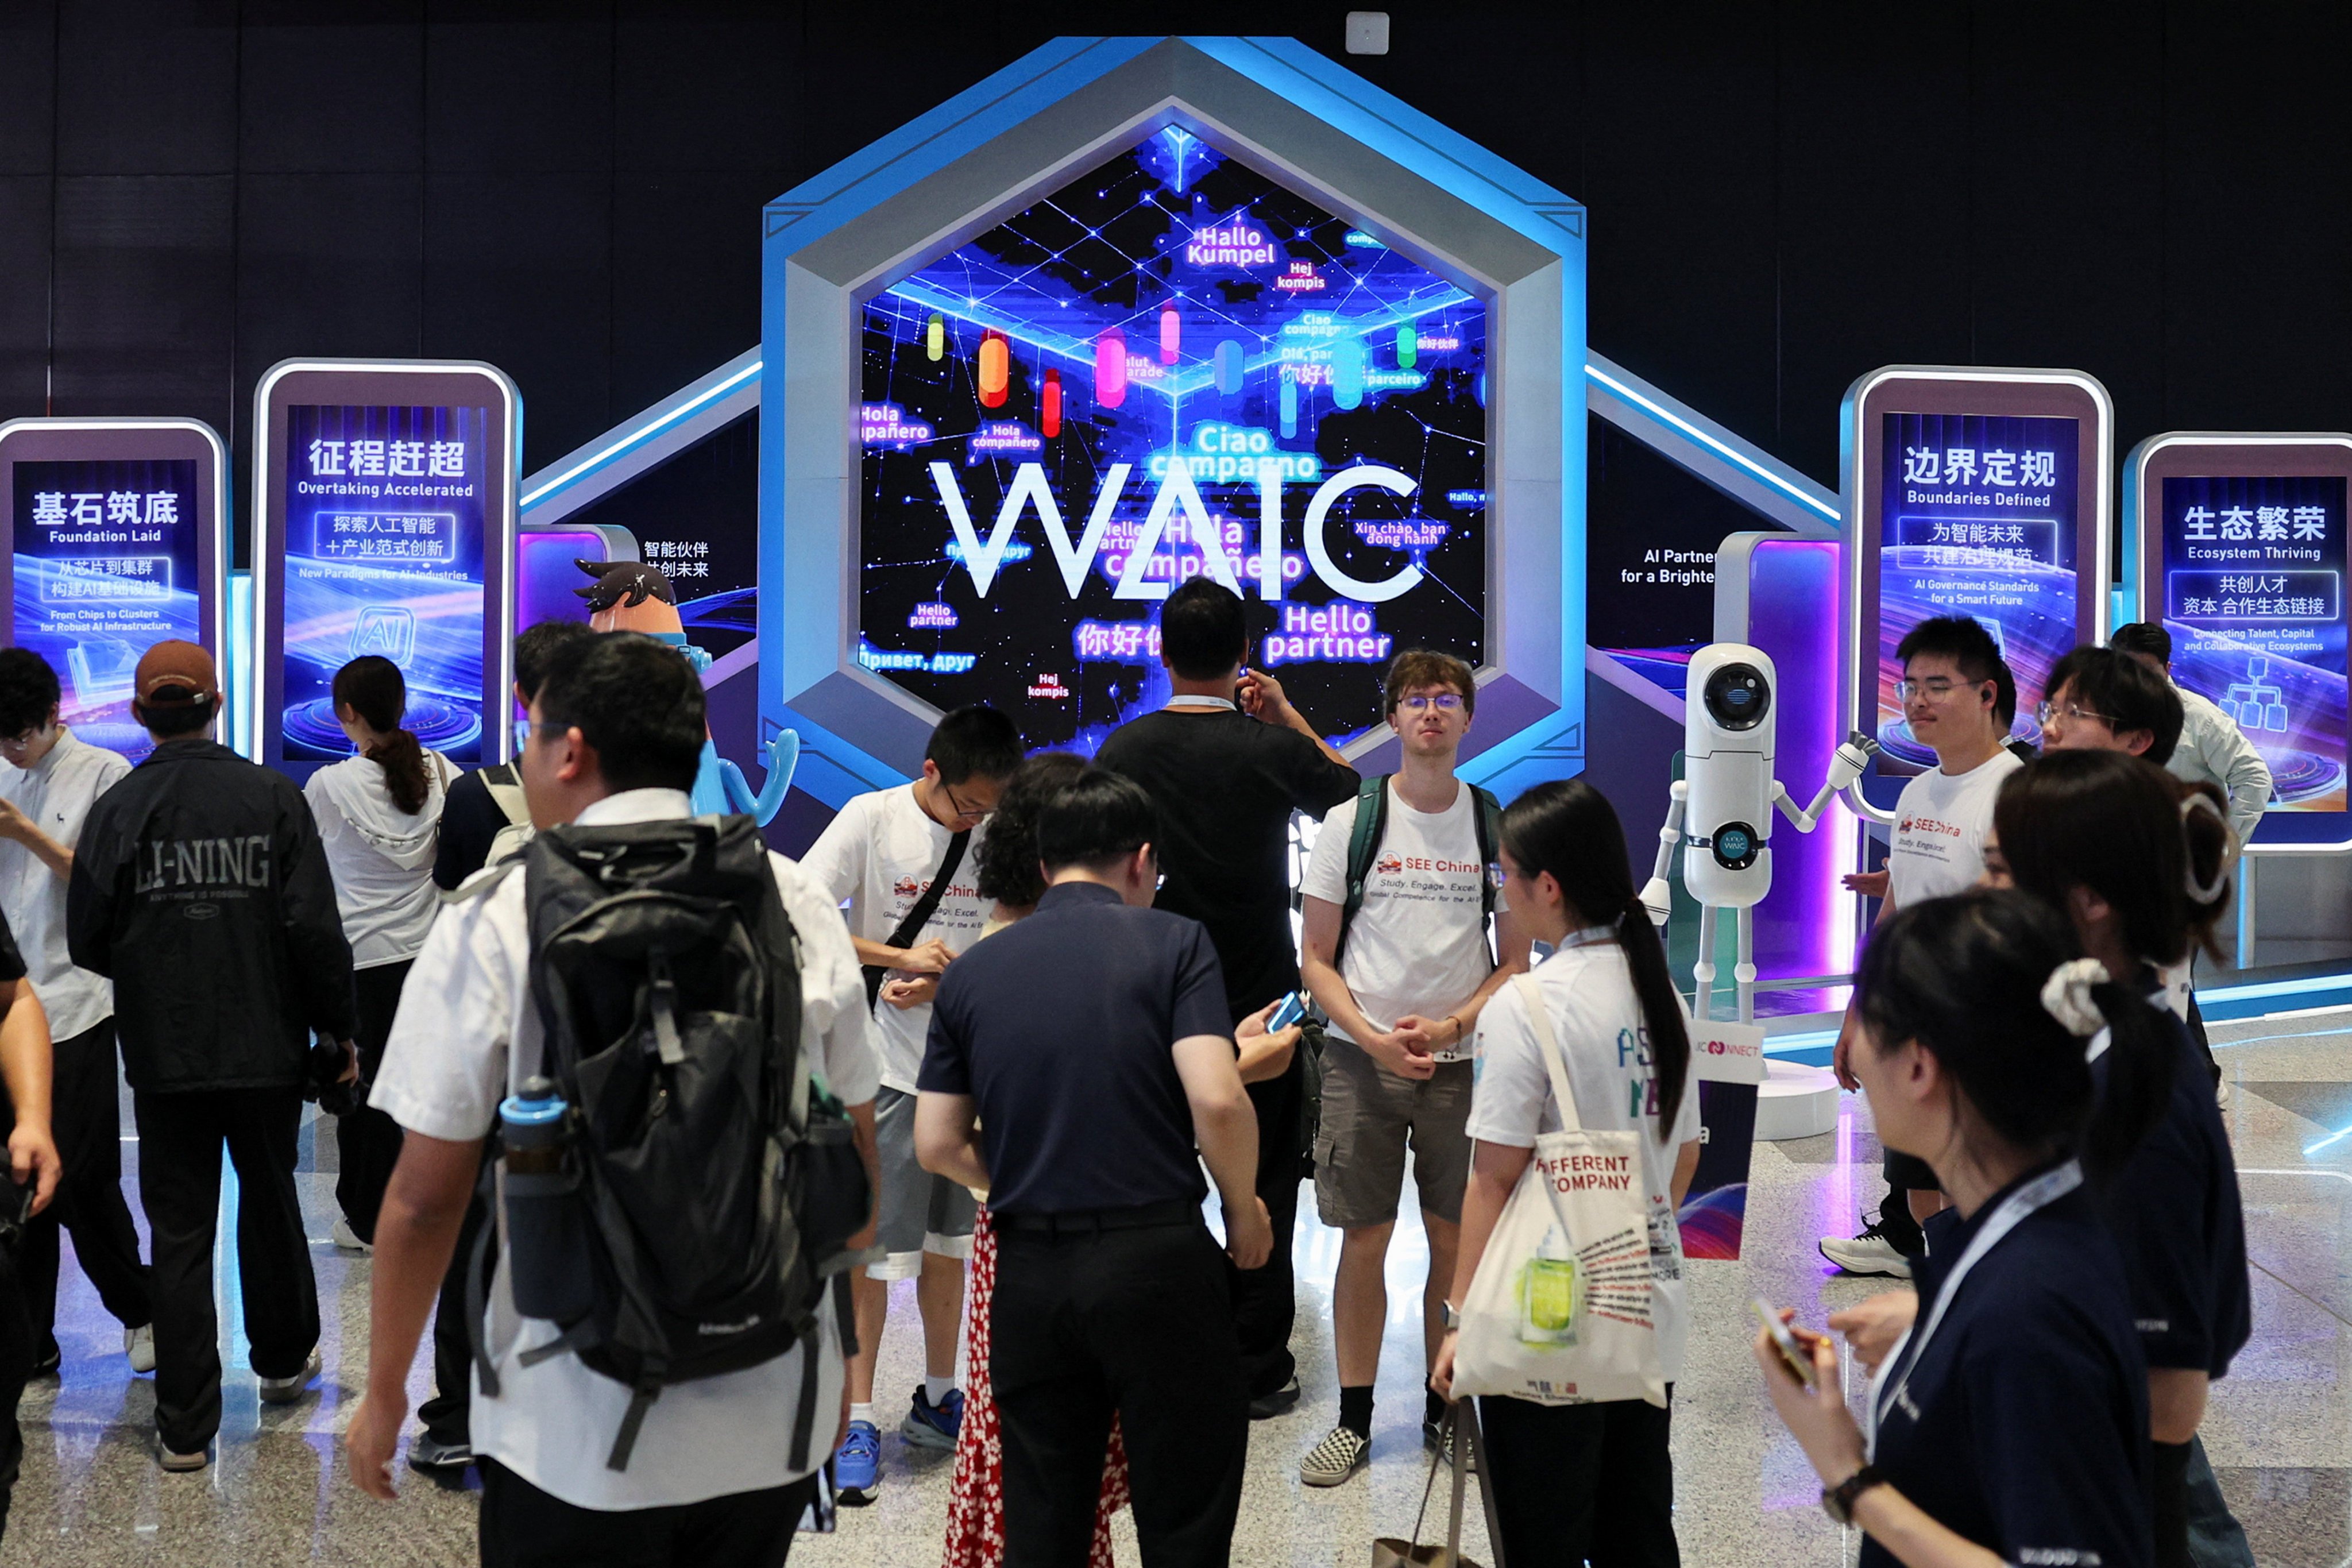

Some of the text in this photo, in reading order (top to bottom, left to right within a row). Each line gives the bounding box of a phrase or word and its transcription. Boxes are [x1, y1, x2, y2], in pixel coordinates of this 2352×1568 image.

[1202, 227, 1261, 246] Hallo
[1188, 244, 1275, 268] Kumpel
[1290, 262, 1312, 276] Hej
[1277, 276, 1325, 291] kompis
[1303, 314, 1331, 325] Ciao
[1125, 356, 1149, 367] alut
[1126, 365, 1163, 377] arade
[1368, 373, 1421, 387] parceiro
[862, 422, 928, 442] pañero
[992, 424, 1020, 436] Hola
[972, 436, 1040, 449] compañero
[1198, 426, 1268, 453] Ciao
[308, 439, 466, 477] 征程赶超
[1903, 446, 2056, 487] 边界定规
[298, 481, 473, 497] Overtaking Accelerated
[1449, 492, 1477, 503] Hallo,
[1907, 490, 2050, 507] Boundaries Defined
[33, 491, 179, 526] 基石筑底
[334, 516, 437, 534] 探索人工智能
[1166, 513, 1243, 543] Hla
[1355, 522, 1377, 535] Xin
[2184, 505, 2326, 541] 生态繁荣
[50, 529, 161, 543] Foundation Laid
[929, 461, 1424, 603] WAIC
[1932, 522, 2025, 544] 为智能未来
[326, 538, 443, 557] +产业范式创新
[644, 540, 709, 558] 智能伙伴
[2188, 546, 2321, 561] Ecosystem Thriving
[1644, 549, 1659, 563] AI
[1923, 545, 2033, 567] 共建治理规范
[59, 559, 153, 576] 从芯片到集群
[299, 567, 322, 578] New
[325, 569, 380, 581] Paradigms
[381, 569, 396, 580] for
[1621, 569, 1715, 586] for a Brighte
[1915, 579, 2040, 592] AI Governance Standards
[2219, 576, 2288, 593] 共创人才
[51, 580, 161, 597] 构建AI基础设施
[1931, 593, 2023, 605] for a Smart Future
[2183, 597, 2325, 615] 资本 合作生态链接
[51, 609, 159, 620] From Chips to Clusters
[917, 604, 951, 616] Hello
[1287, 604, 1371, 632] Hello
[41, 621, 172, 632] for Robust AI Infrastructure
[910, 615, 957, 627] partner
[361, 616, 401, 652] AI
[2193, 628, 2315, 640] Connecting Talent, Capital
[1267, 635, 1391, 665] partner
[2184, 641, 2324, 652] and Collaborative Ecosystems
[859, 654, 975, 671] Привет, друг
[1038, 673, 1059, 687] Hej
[1028, 686, 1069, 698] kompis
[1914, 818, 1935, 832] SEE
[134, 834, 271, 894] LI-NING
[1405, 858, 1480, 873] SEE China
[1380, 879, 1477, 892] Study. Engage. Excel.
[1552, 1174, 1631, 1193] OMPANY
